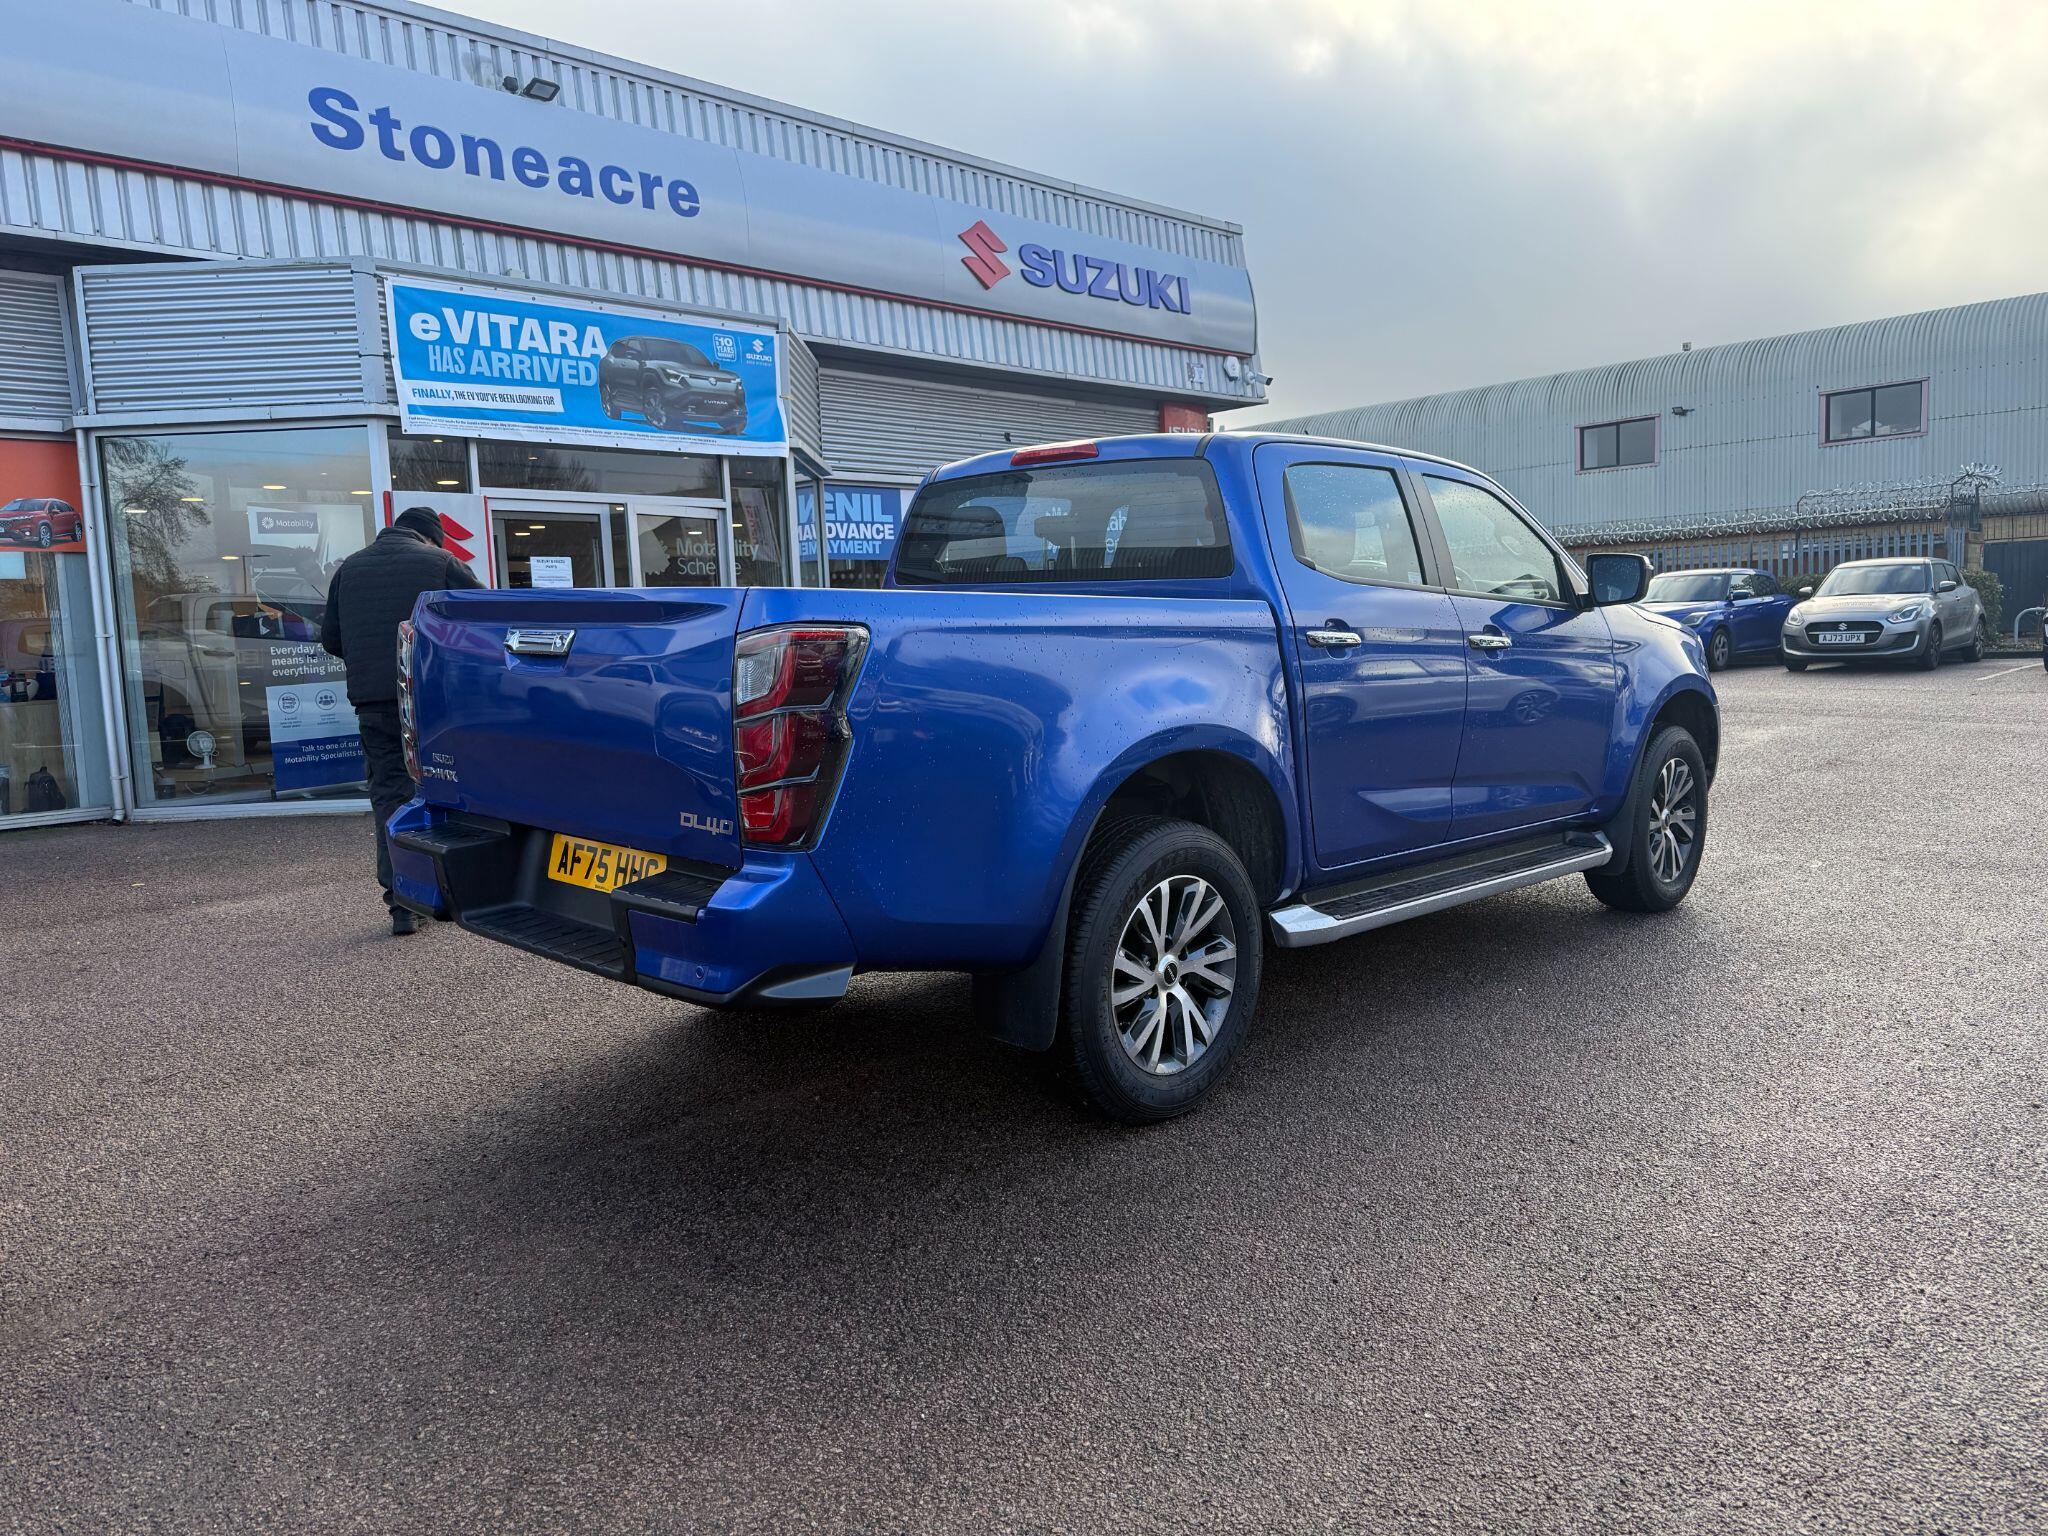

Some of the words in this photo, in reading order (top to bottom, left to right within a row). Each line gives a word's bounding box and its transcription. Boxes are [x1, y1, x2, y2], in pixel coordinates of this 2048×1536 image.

[308, 87, 700, 217] Stoneacre
[1019, 243, 1192, 315] SUZUKI
[428, 344, 465, 375] HAS
[469, 349, 598, 387] ARRIVED
[746, 353, 772, 361] SUZUKI
[411, 387, 455, 401] FINALLY,
[453, 390, 467, 401] THE
[467, 391, 475, 401] EV
[474, 391, 498, 402] YOU'VE
[498, 393, 516, 404] BEEN
[515, 394, 543, 405] LOOKING
[543, 396, 555, 406] FOR
[825, 522, 895, 540] DVANCE
[676, 538, 759, 561] Motality
[677, 558, 742, 575] Schee
[270, 645, 315, 656] Everyday
[271, 656, 304, 666] means
[272, 664, 325, 677] everything
[284, 753, 319, 764] Motability
[320, 750, 359, 761] Specialists
[679, 811, 734, 835] DL40
[556, 840, 611, 884] AF75
